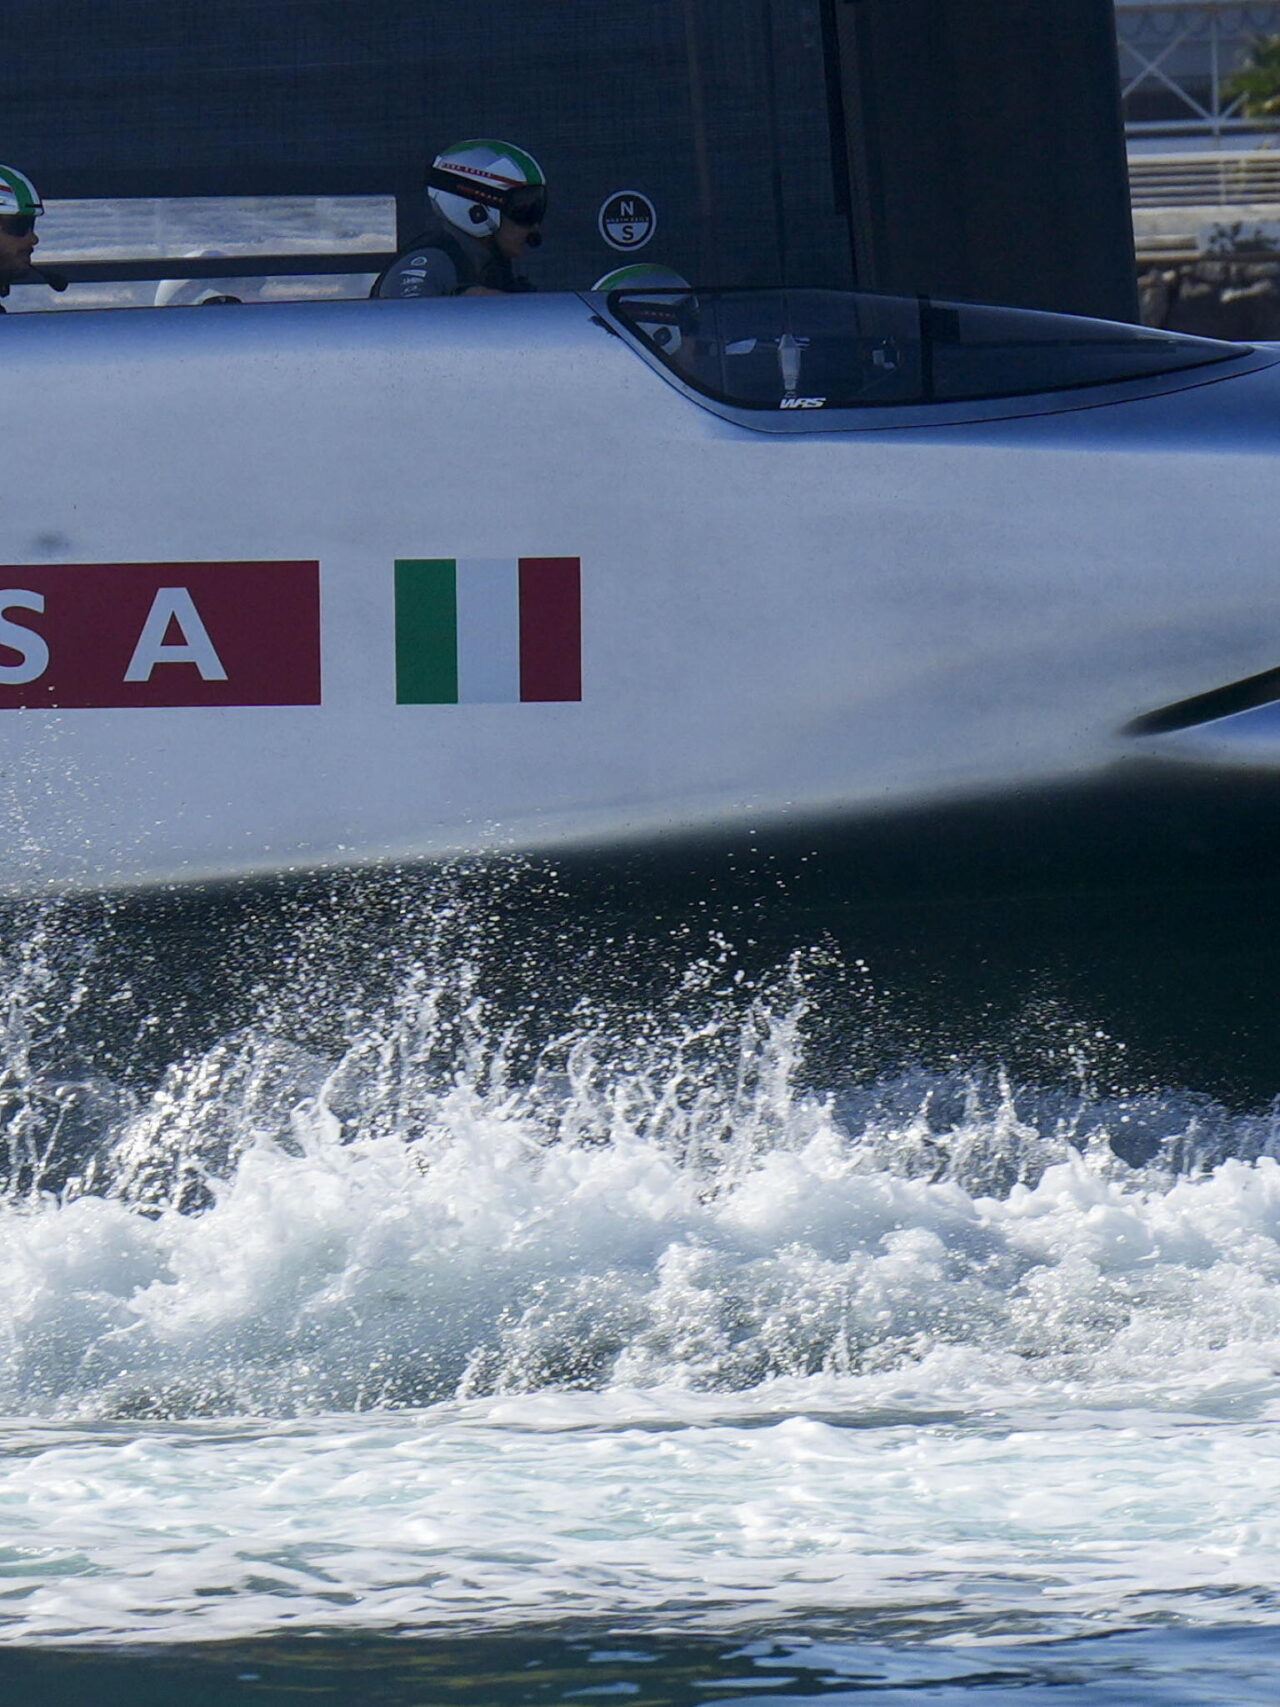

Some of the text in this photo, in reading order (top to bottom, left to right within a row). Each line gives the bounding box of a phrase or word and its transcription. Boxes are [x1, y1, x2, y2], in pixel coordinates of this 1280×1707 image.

[620, 201, 634, 216] N
[622, 225, 634, 240] S
[780, 398, 827, 409] WRS
